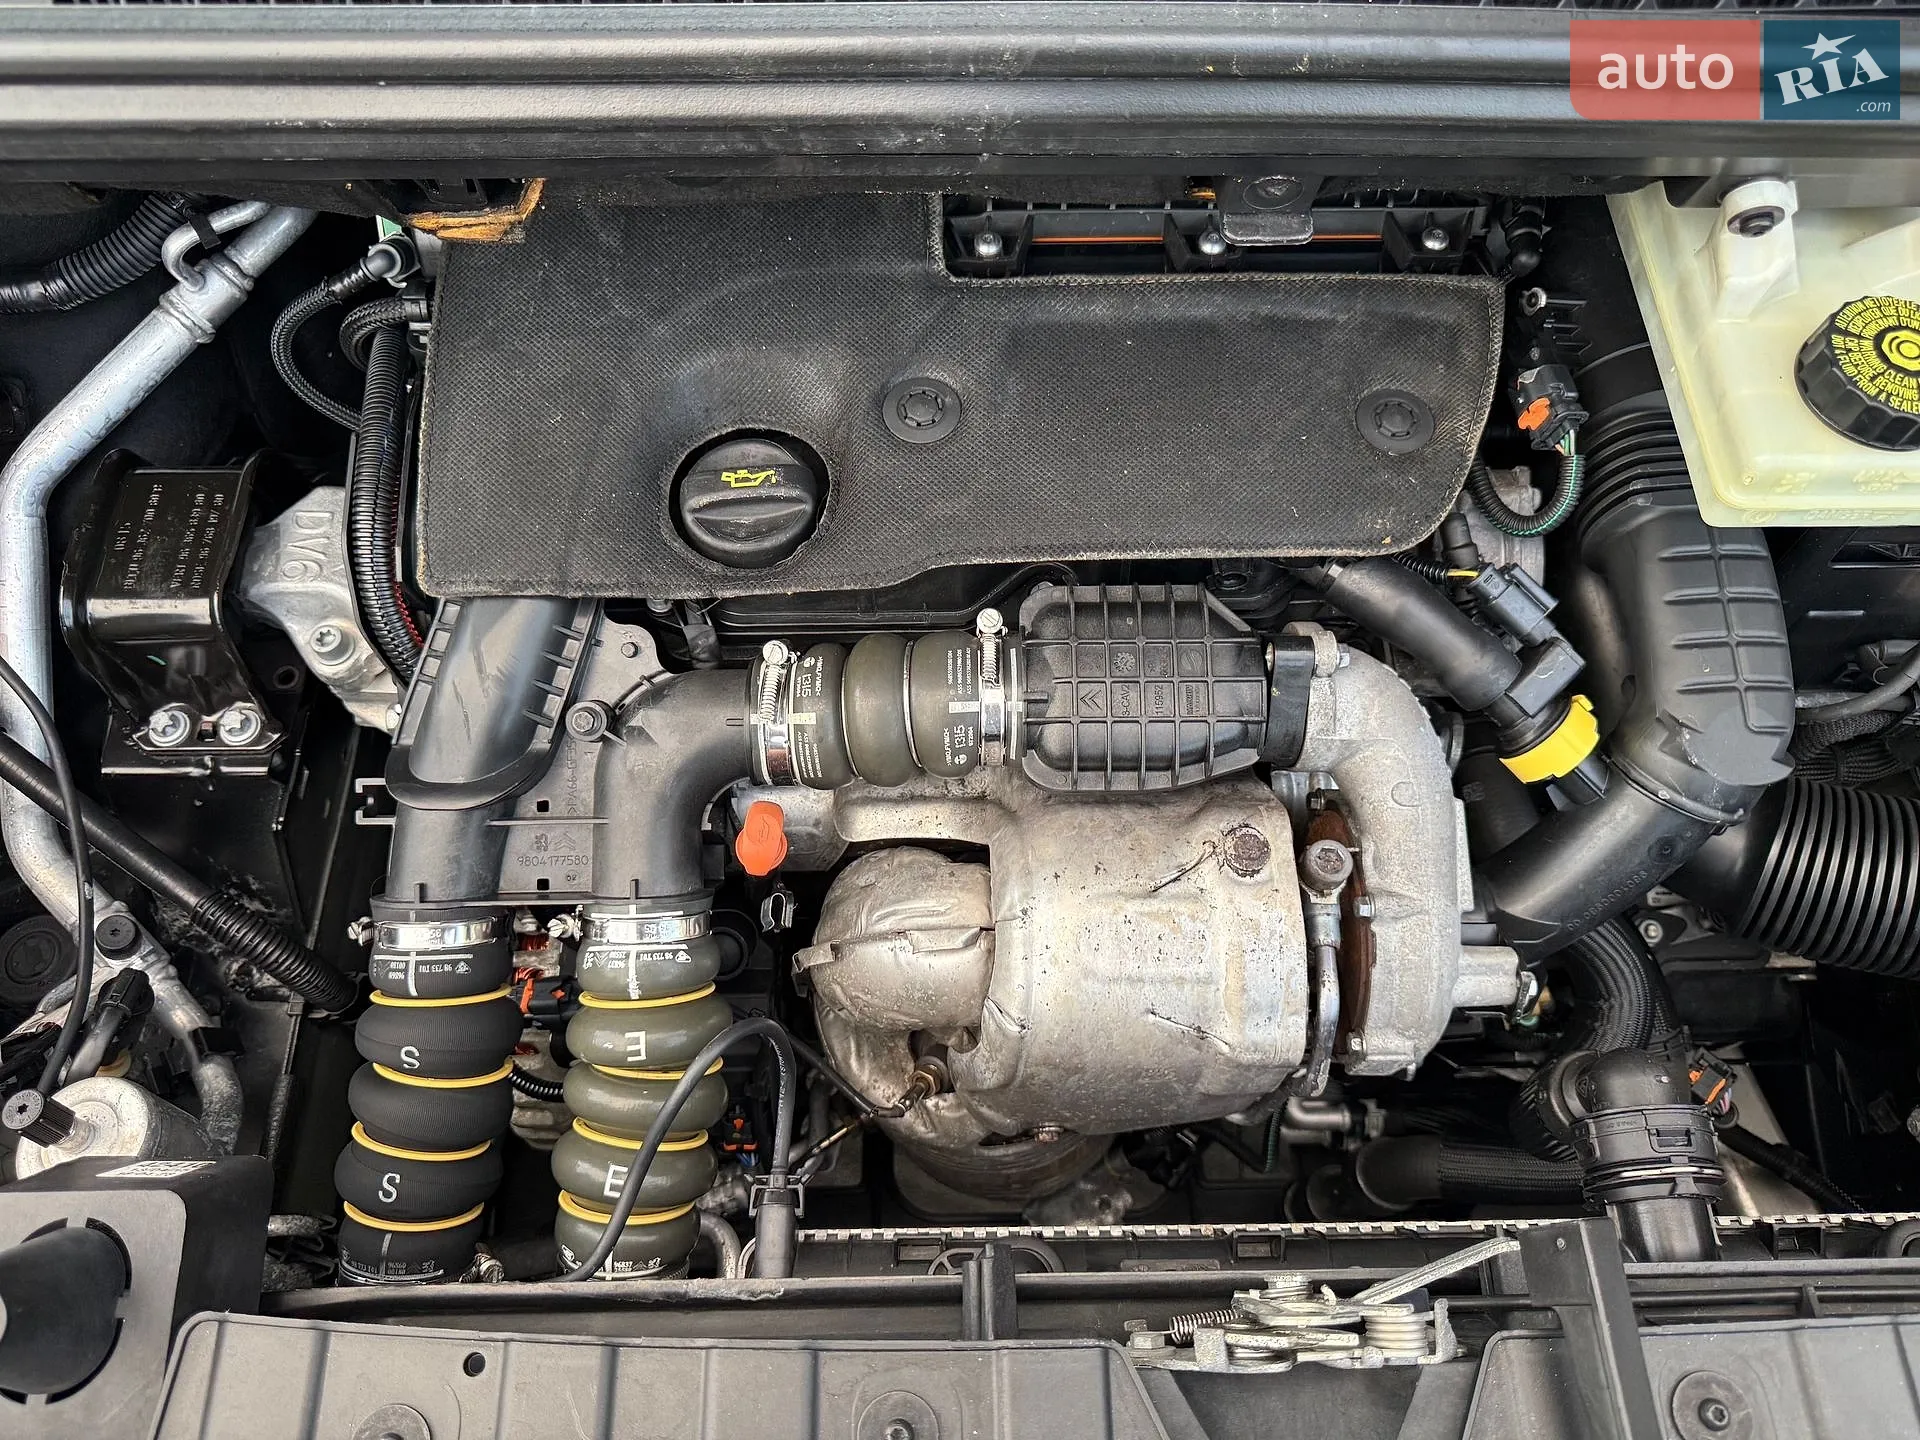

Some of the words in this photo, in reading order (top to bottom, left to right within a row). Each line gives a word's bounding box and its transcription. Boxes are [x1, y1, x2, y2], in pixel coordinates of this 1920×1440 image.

[1832, 334, 1844, 348] DOT
[1845, 337, 1860, 352] CAP
[1836, 355, 1858, 377] FLUID
[1848, 352, 1878, 380] BEFORE
[1859, 339, 1887, 373] WARNING
[1884, 369, 1918, 389] CLEAN
[1853, 375, 1879, 397] FROM
[1873, 376, 1918, 400] REMOVING
[1877, 394, 1886, 403] A
[516, 854, 589, 866] 9804177580
[400, 1045, 420, 1069] S
[625, 1030, 646, 1061] E
[378, 1172, 401, 1203] S
